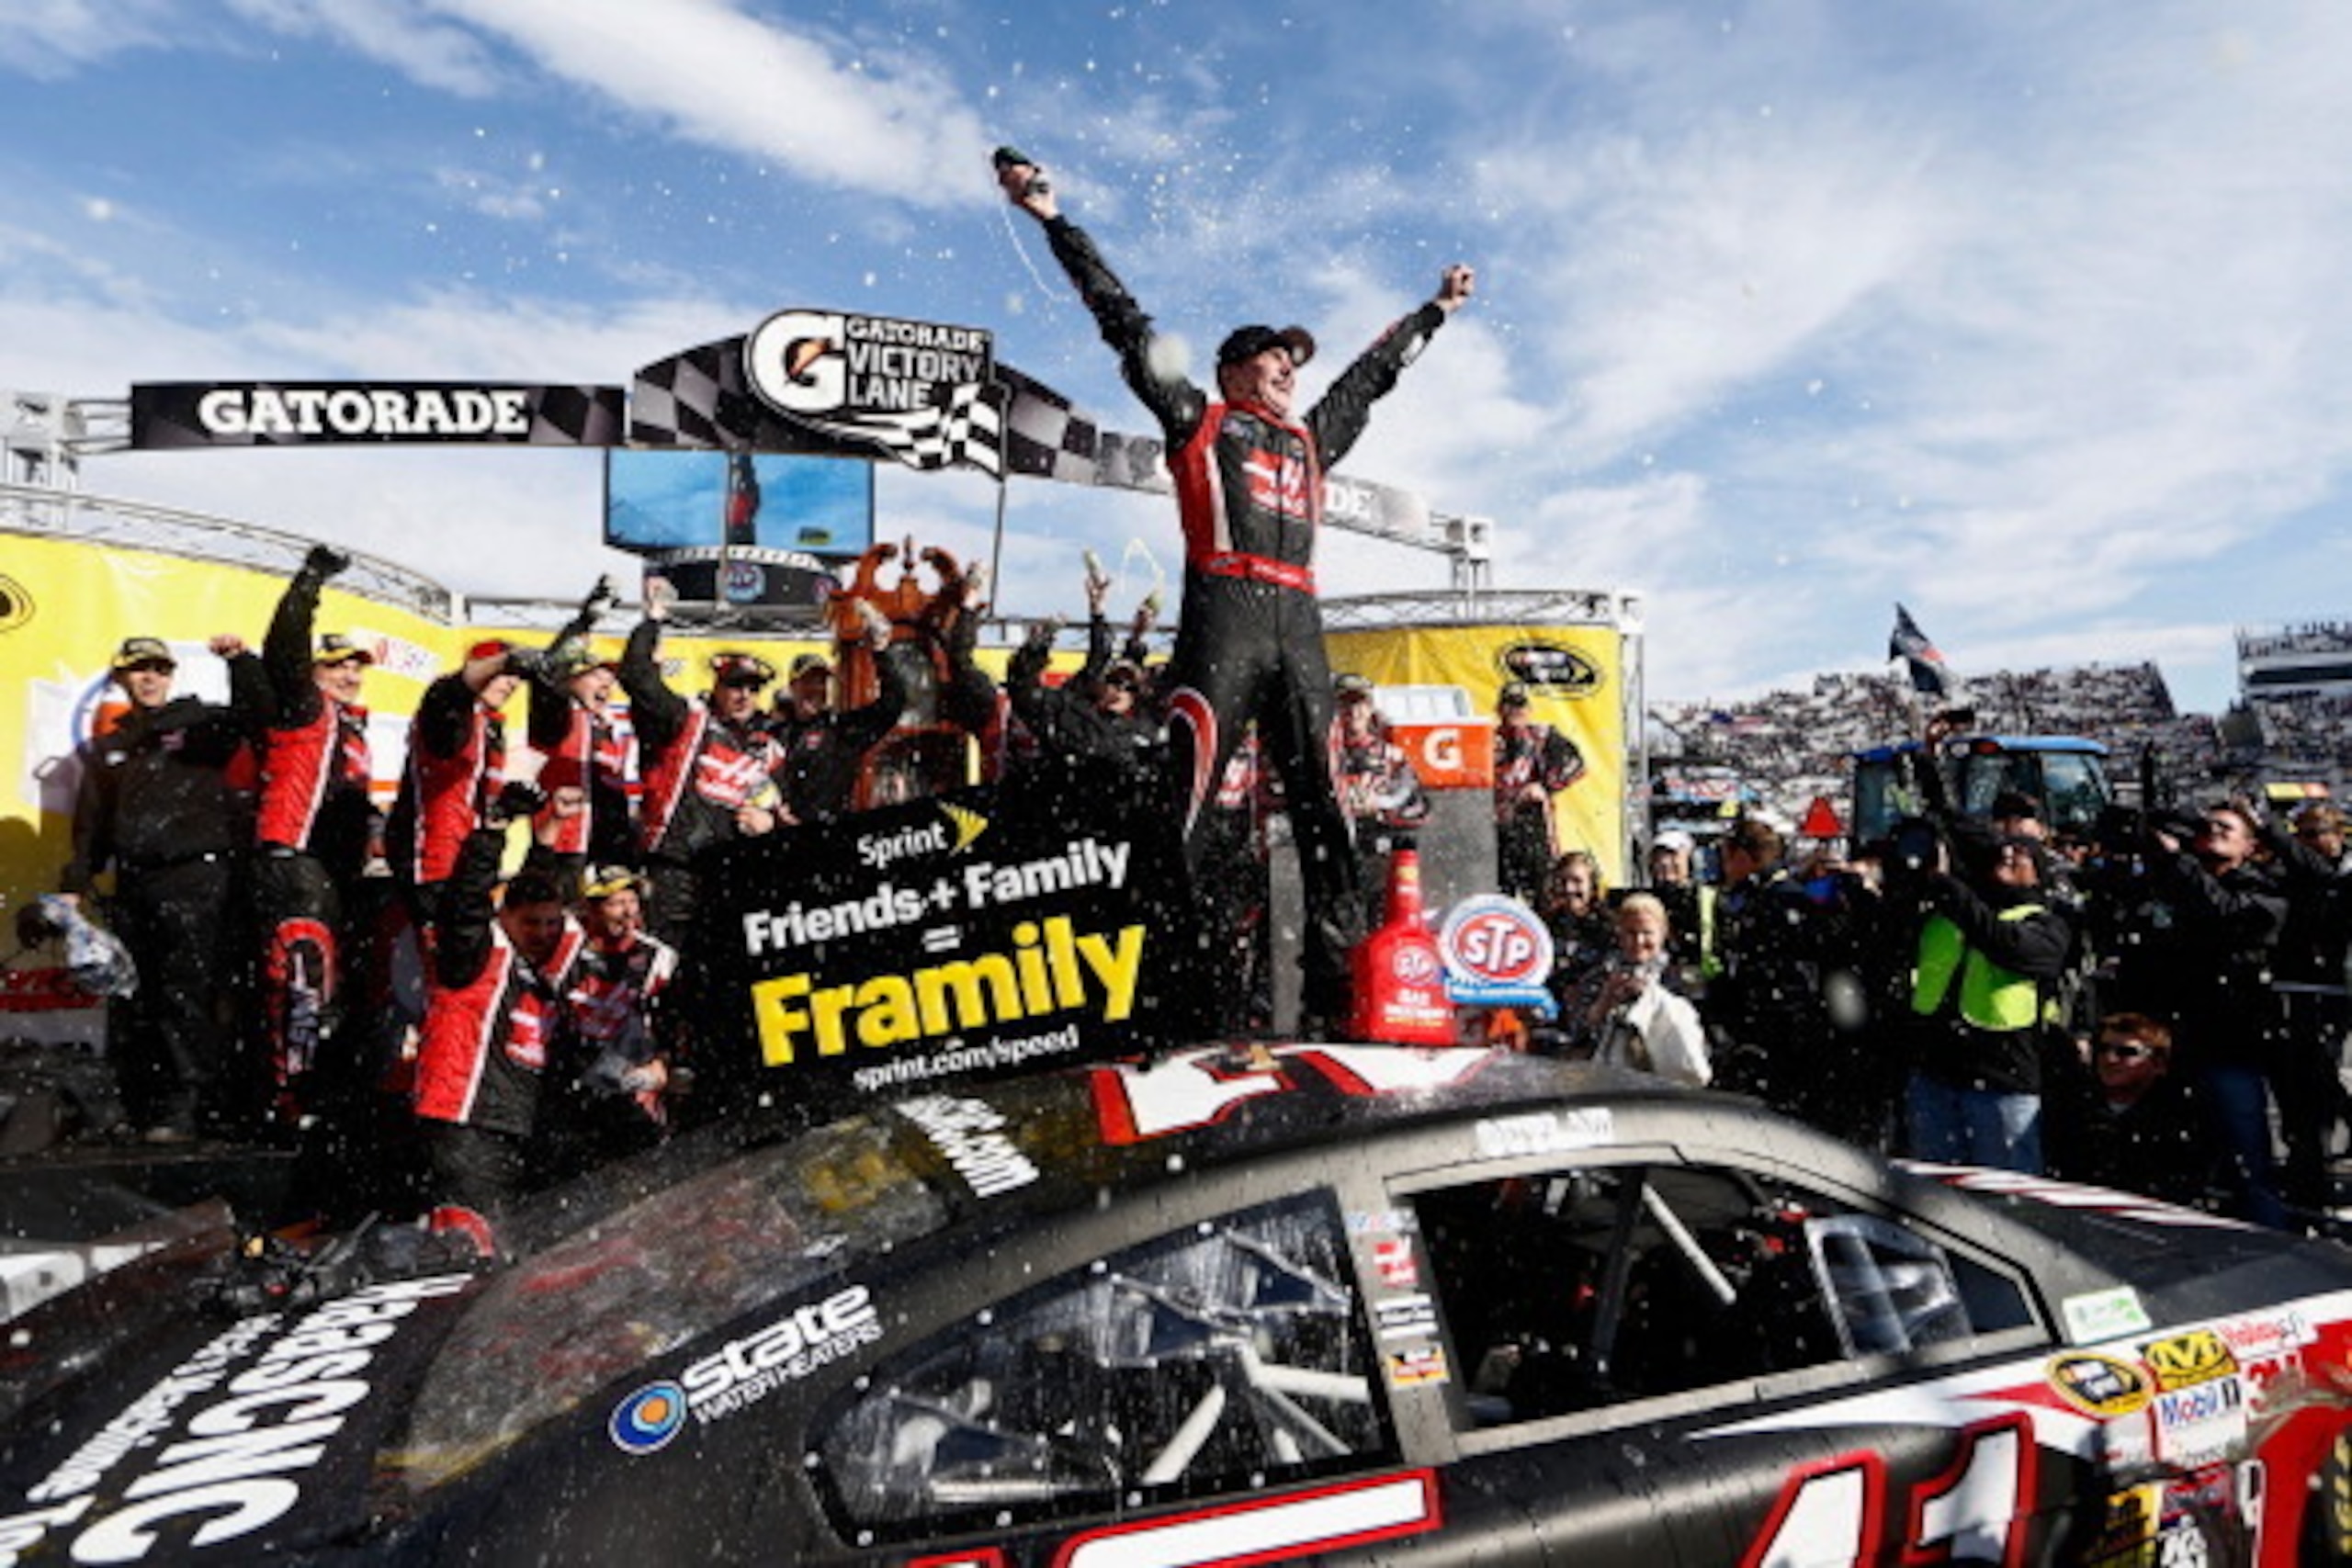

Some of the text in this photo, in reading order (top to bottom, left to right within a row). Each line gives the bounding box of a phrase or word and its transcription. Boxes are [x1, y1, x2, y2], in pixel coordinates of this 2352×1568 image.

[846, 318, 989, 354] GATORADE
[846, 343, 984, 382] VICTORY
[199, 390, 528, 434] GATORADE
[847, 373, 933, 410] LANE
[1424, 729, 1463, 770] G
[856, 819, 947, 868] Sprint
[742, 883, 922, 955] Friends
[964, 837, 1131, 908] Family
[1464, 919, 1533, 972] STP
[751, 915, 1147, 1067] Framily
[853, 1022, 1080, 1092] sprint.com/speed
[681, 1284, 870, 1408] state
[693, 1366, 778, 1424] WATER
[2161, 1384, 2218, 1426] Mobil
